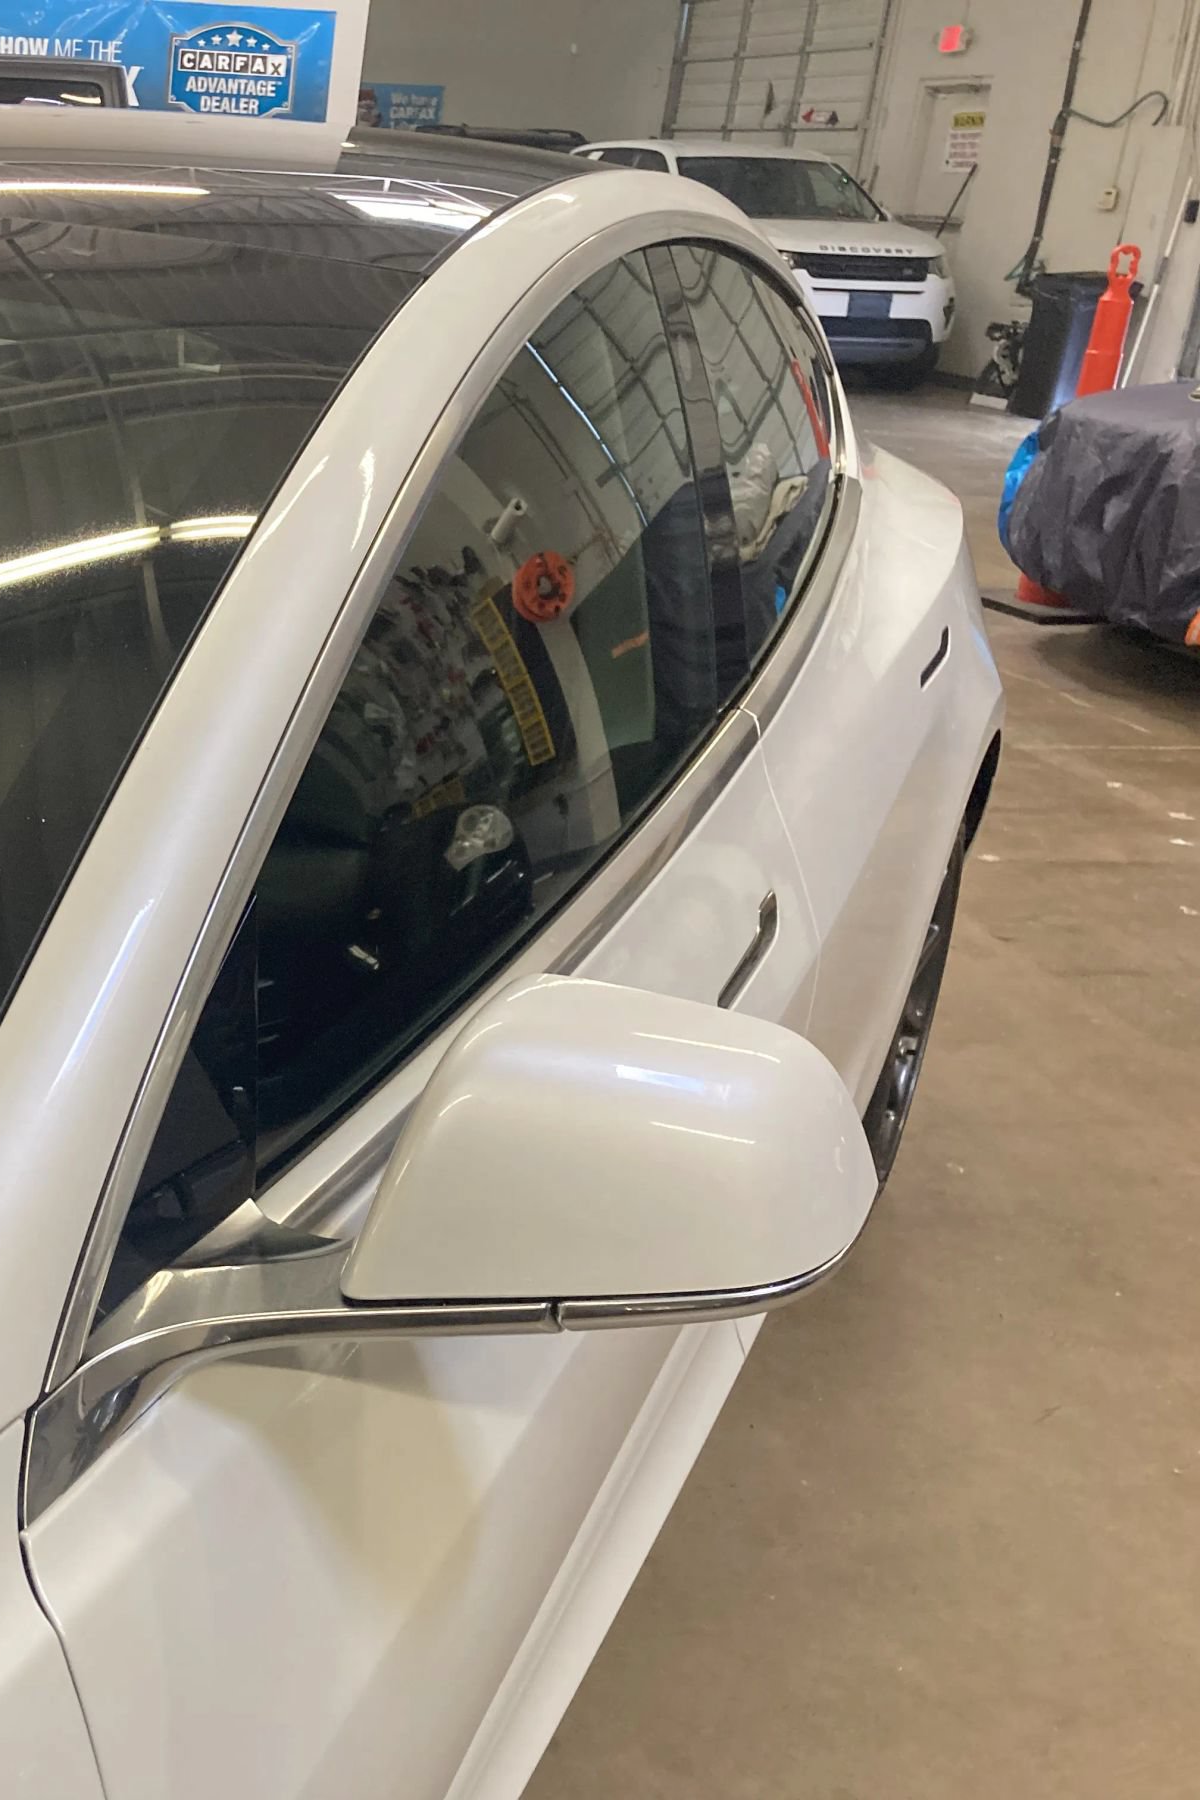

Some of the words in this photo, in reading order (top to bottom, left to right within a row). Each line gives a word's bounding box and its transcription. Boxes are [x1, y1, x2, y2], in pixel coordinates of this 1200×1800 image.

[54, 38, 84, 58] ME
[88, 39, 123, 63] THE
[181, 52, 283, 75] CARFAX
[200, 95, 260, 115] DEALER
[819, 245, 914, 255] DISCOVERY
